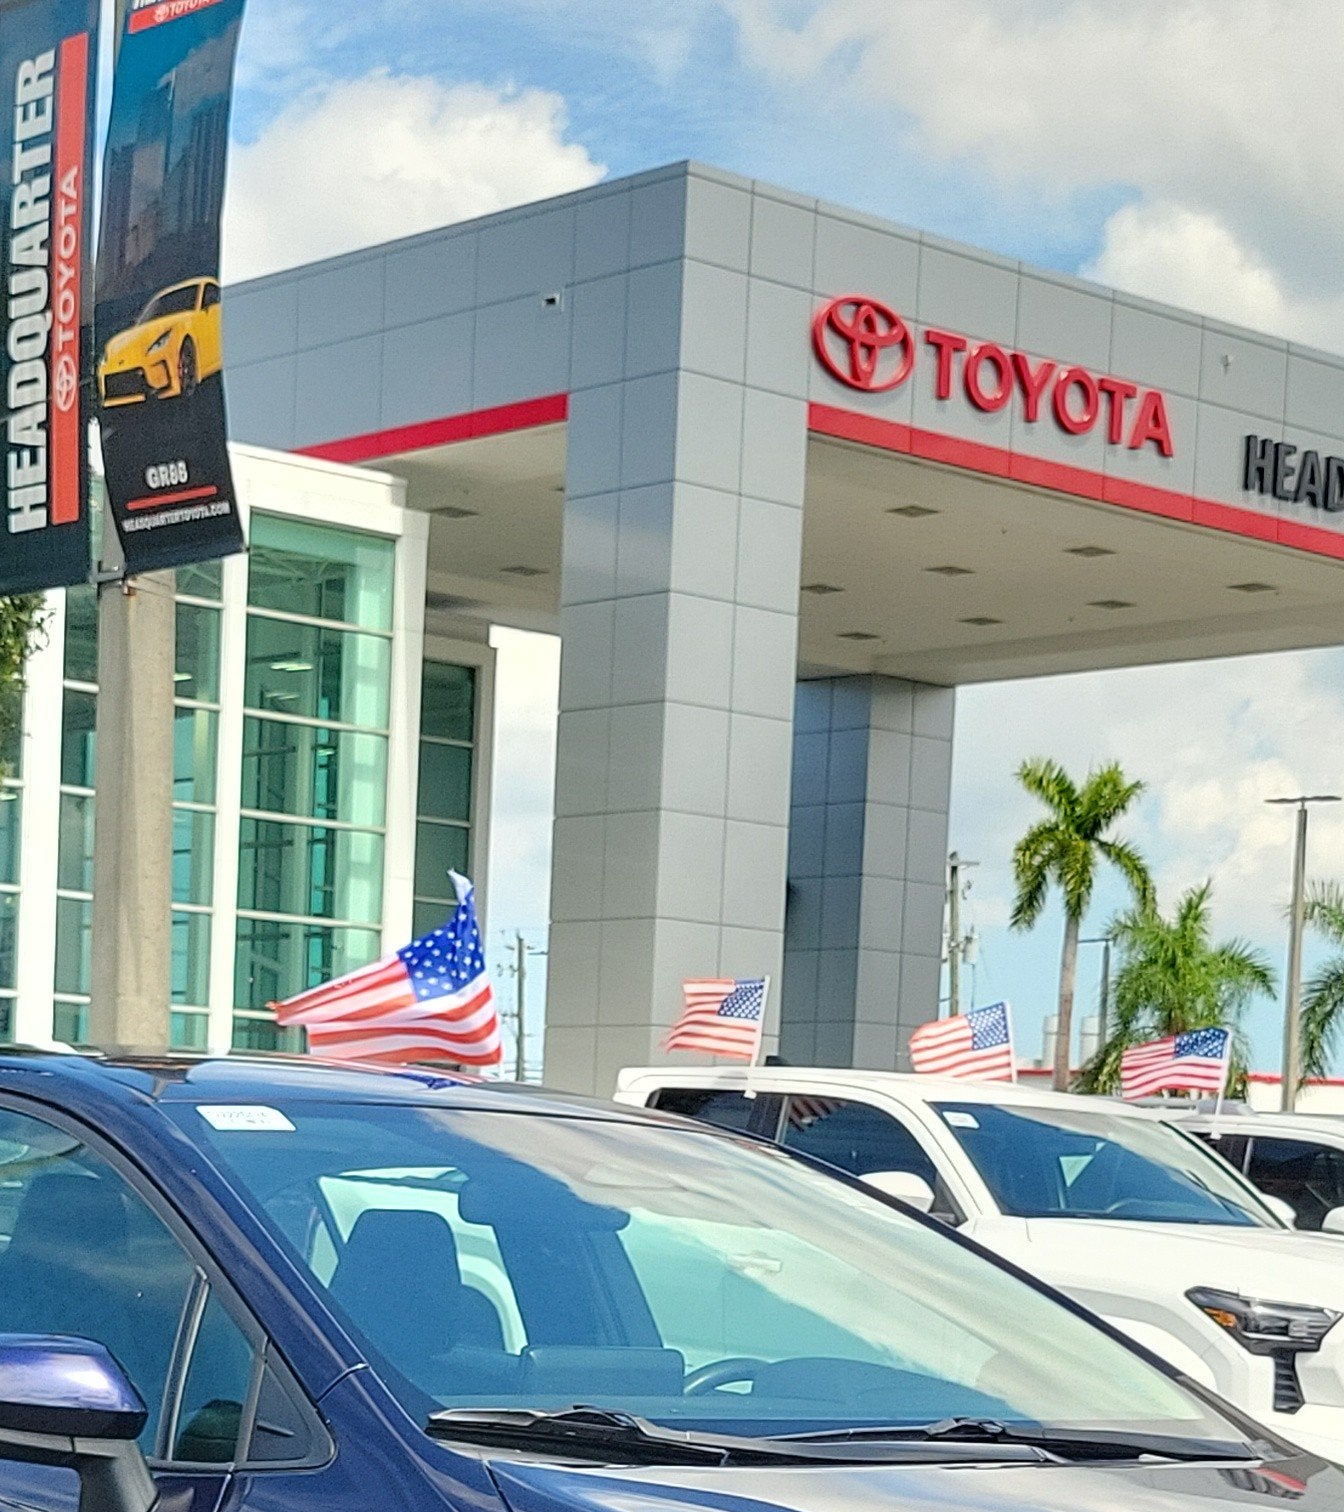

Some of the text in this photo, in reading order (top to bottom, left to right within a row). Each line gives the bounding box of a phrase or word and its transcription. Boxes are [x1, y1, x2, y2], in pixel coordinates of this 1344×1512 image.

[6, 49, 56, 535] HEADQUARTER
[57, 165, 79, 352] TOYOTA
[924, 329, 1173, 457] TOYOTA
